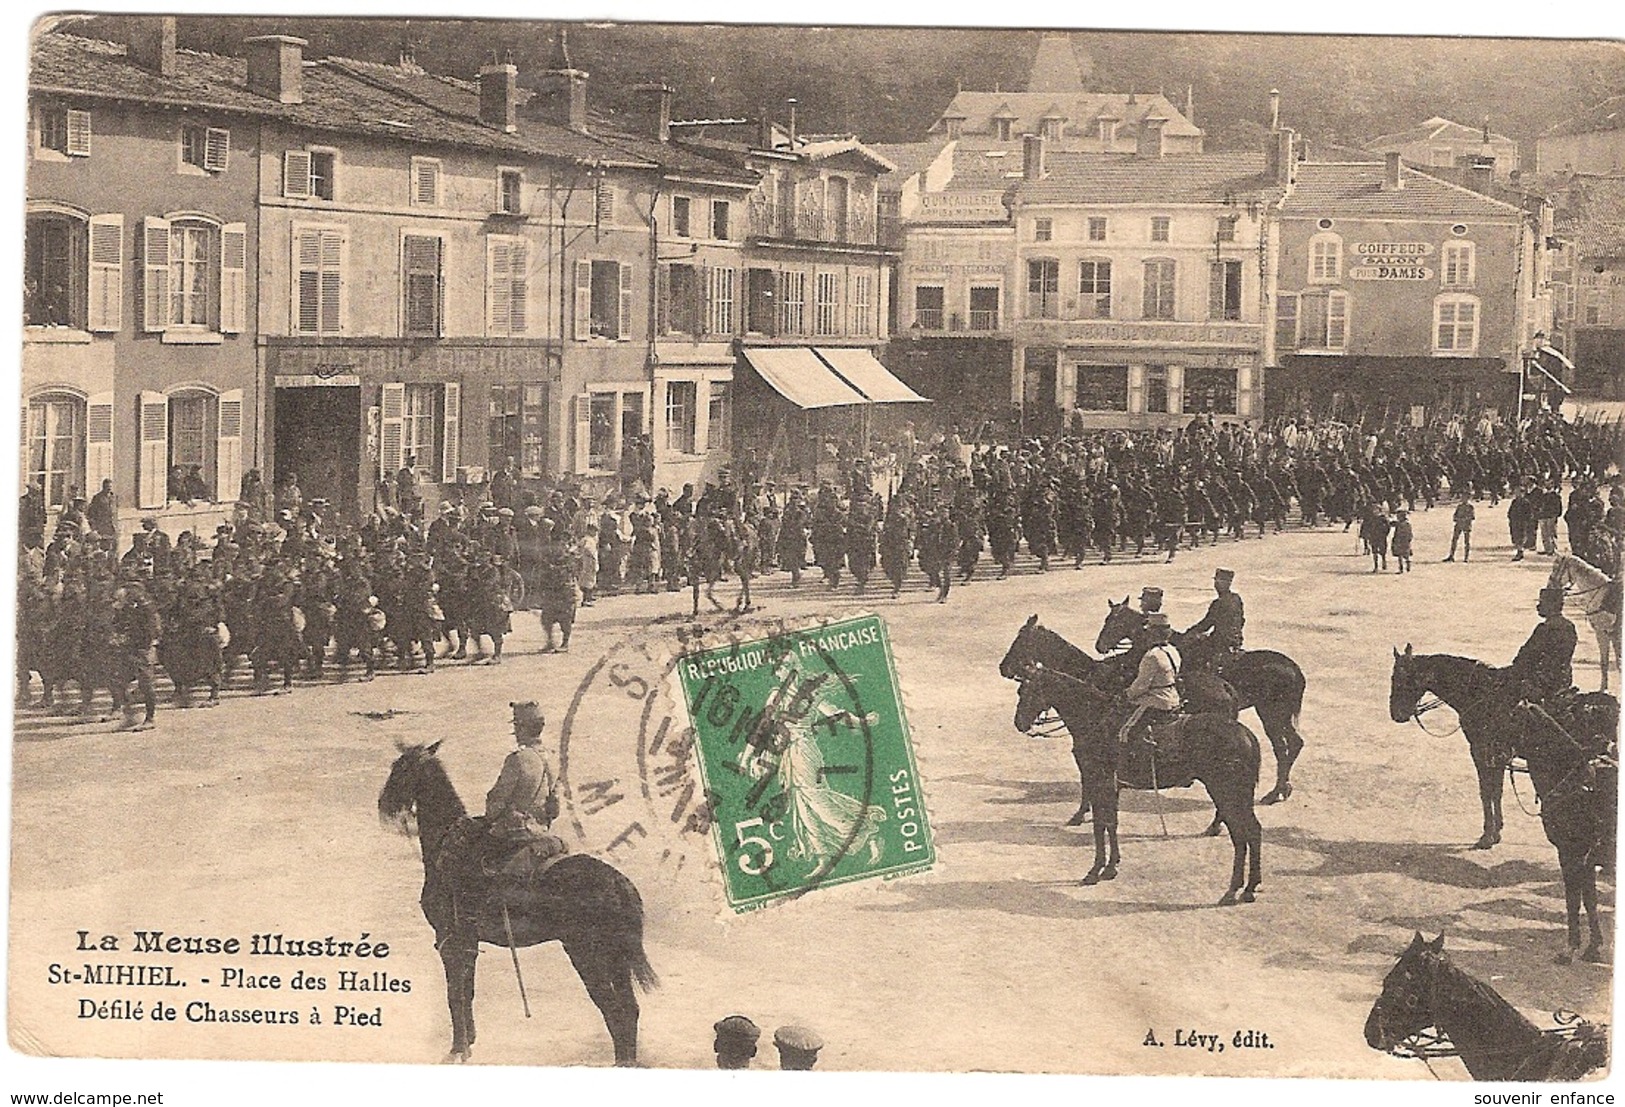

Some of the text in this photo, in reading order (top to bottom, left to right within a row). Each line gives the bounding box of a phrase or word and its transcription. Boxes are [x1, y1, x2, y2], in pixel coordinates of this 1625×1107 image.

[1358, 243, 1426, 254] COIFFEUR
[1365, 256, 1418, 264] SALON
[1378, 267, 1426, 279] DAMES
[799, 626, 880, 657] FRANÇAISE
[890, 769, 922, 852] POSTES
